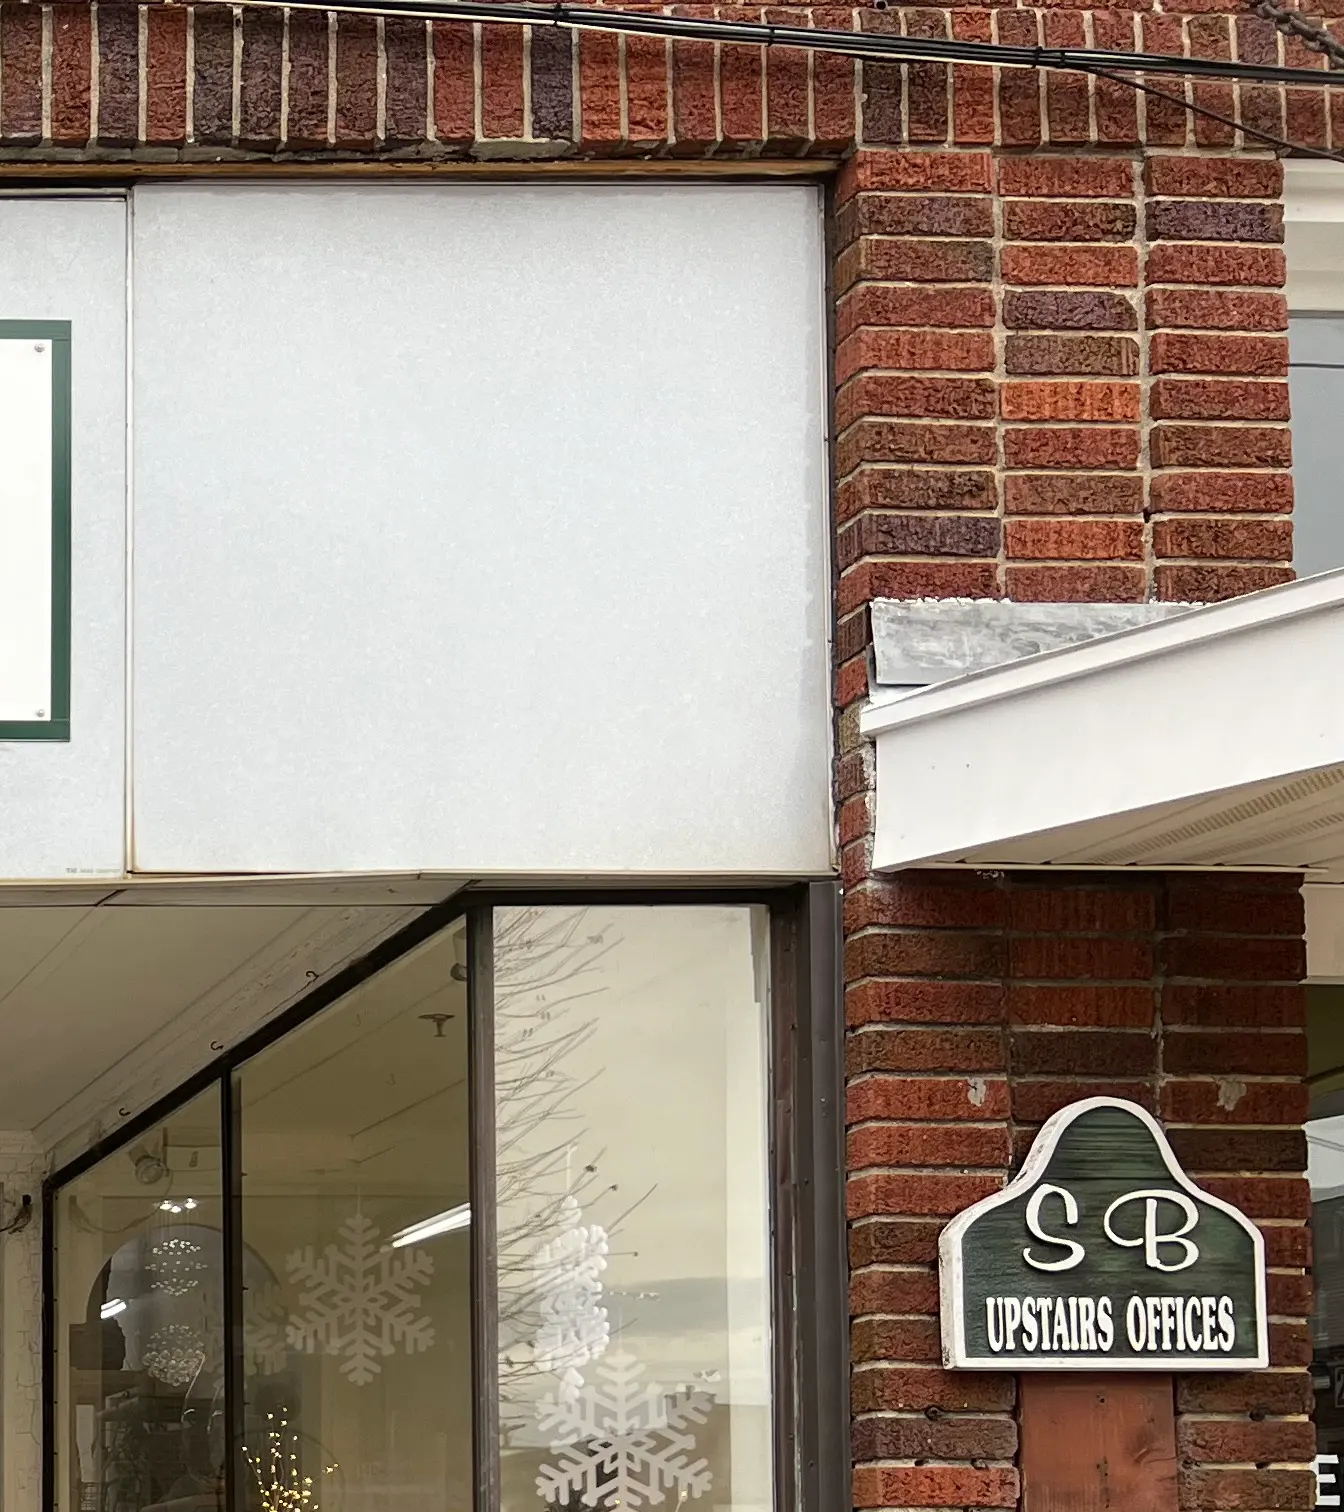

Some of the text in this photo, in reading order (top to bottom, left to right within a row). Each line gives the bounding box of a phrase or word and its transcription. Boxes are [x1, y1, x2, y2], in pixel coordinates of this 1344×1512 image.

[1023, 1184, 1200, 1272] S B
[986, 1295, 1236, 1352] UPSTAIRS OFFICES
